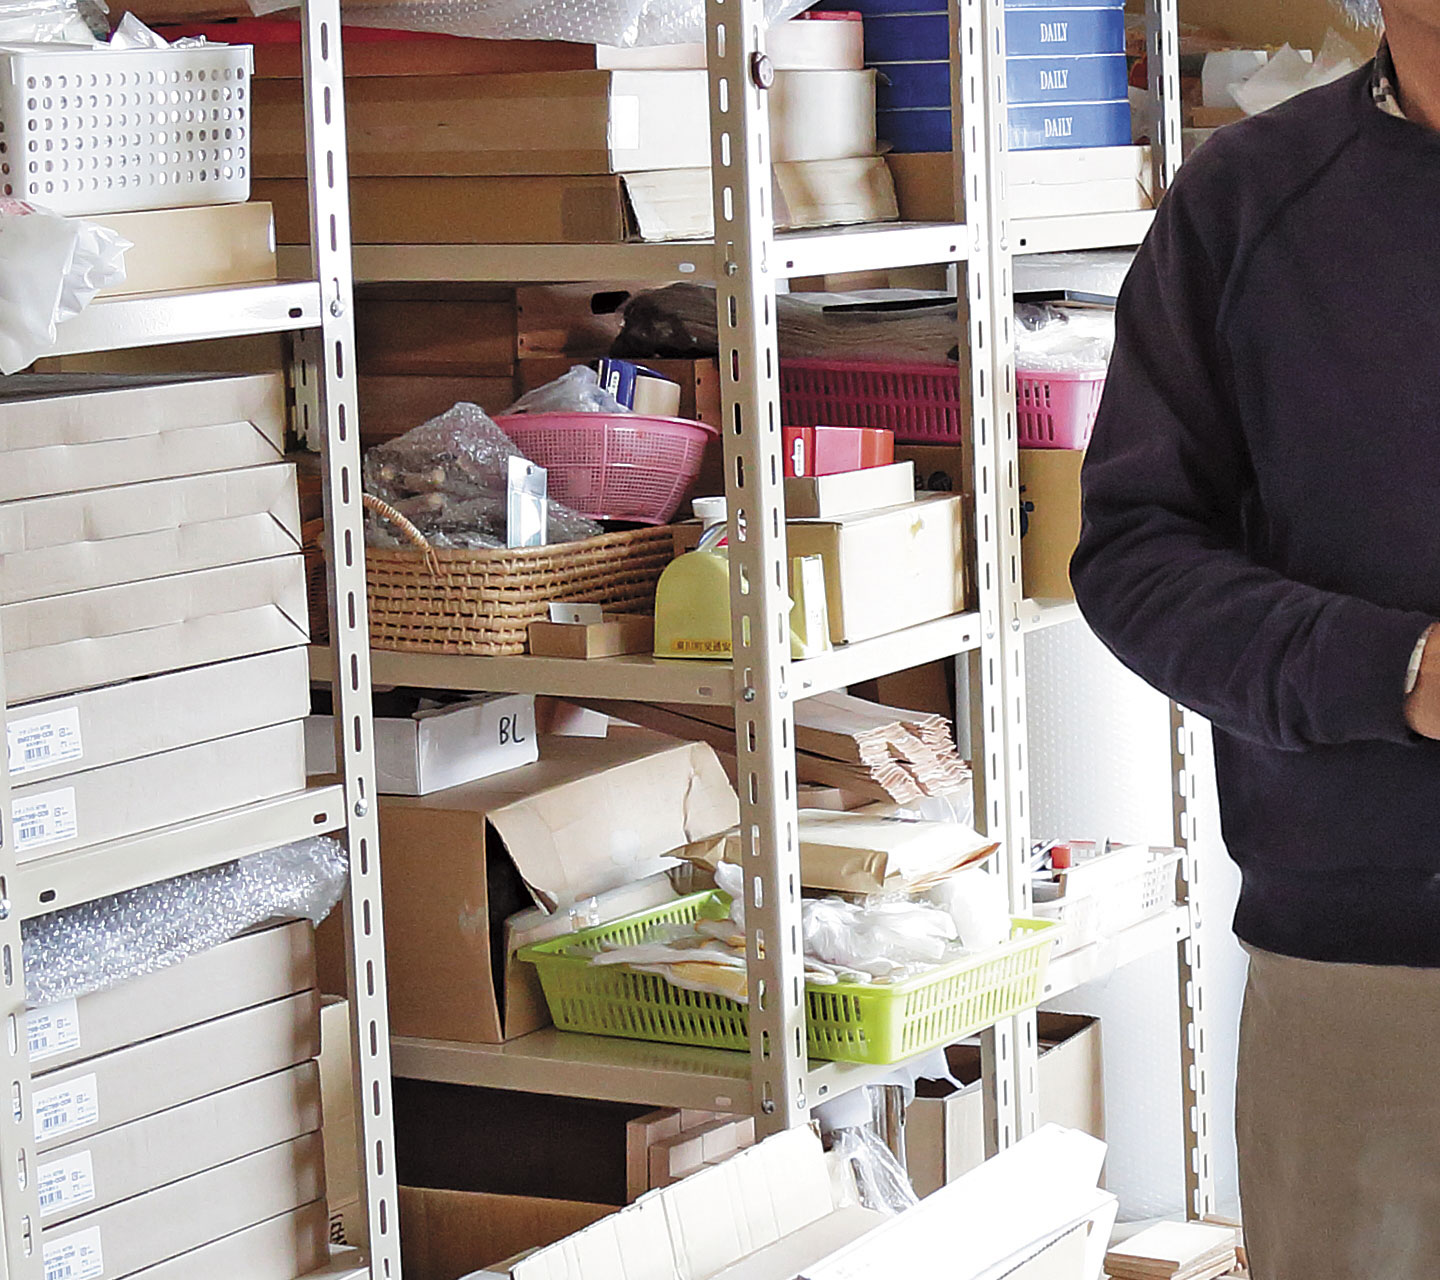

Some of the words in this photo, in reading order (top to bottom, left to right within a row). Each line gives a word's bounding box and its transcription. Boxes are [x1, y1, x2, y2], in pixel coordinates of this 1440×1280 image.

[1040, 22, 1068, 43] DAILY
[1040, 69, 1068, 90] DAILY
[1044, 117, 1073, 138] DAILY
[500, 713, 525, 745] BL
